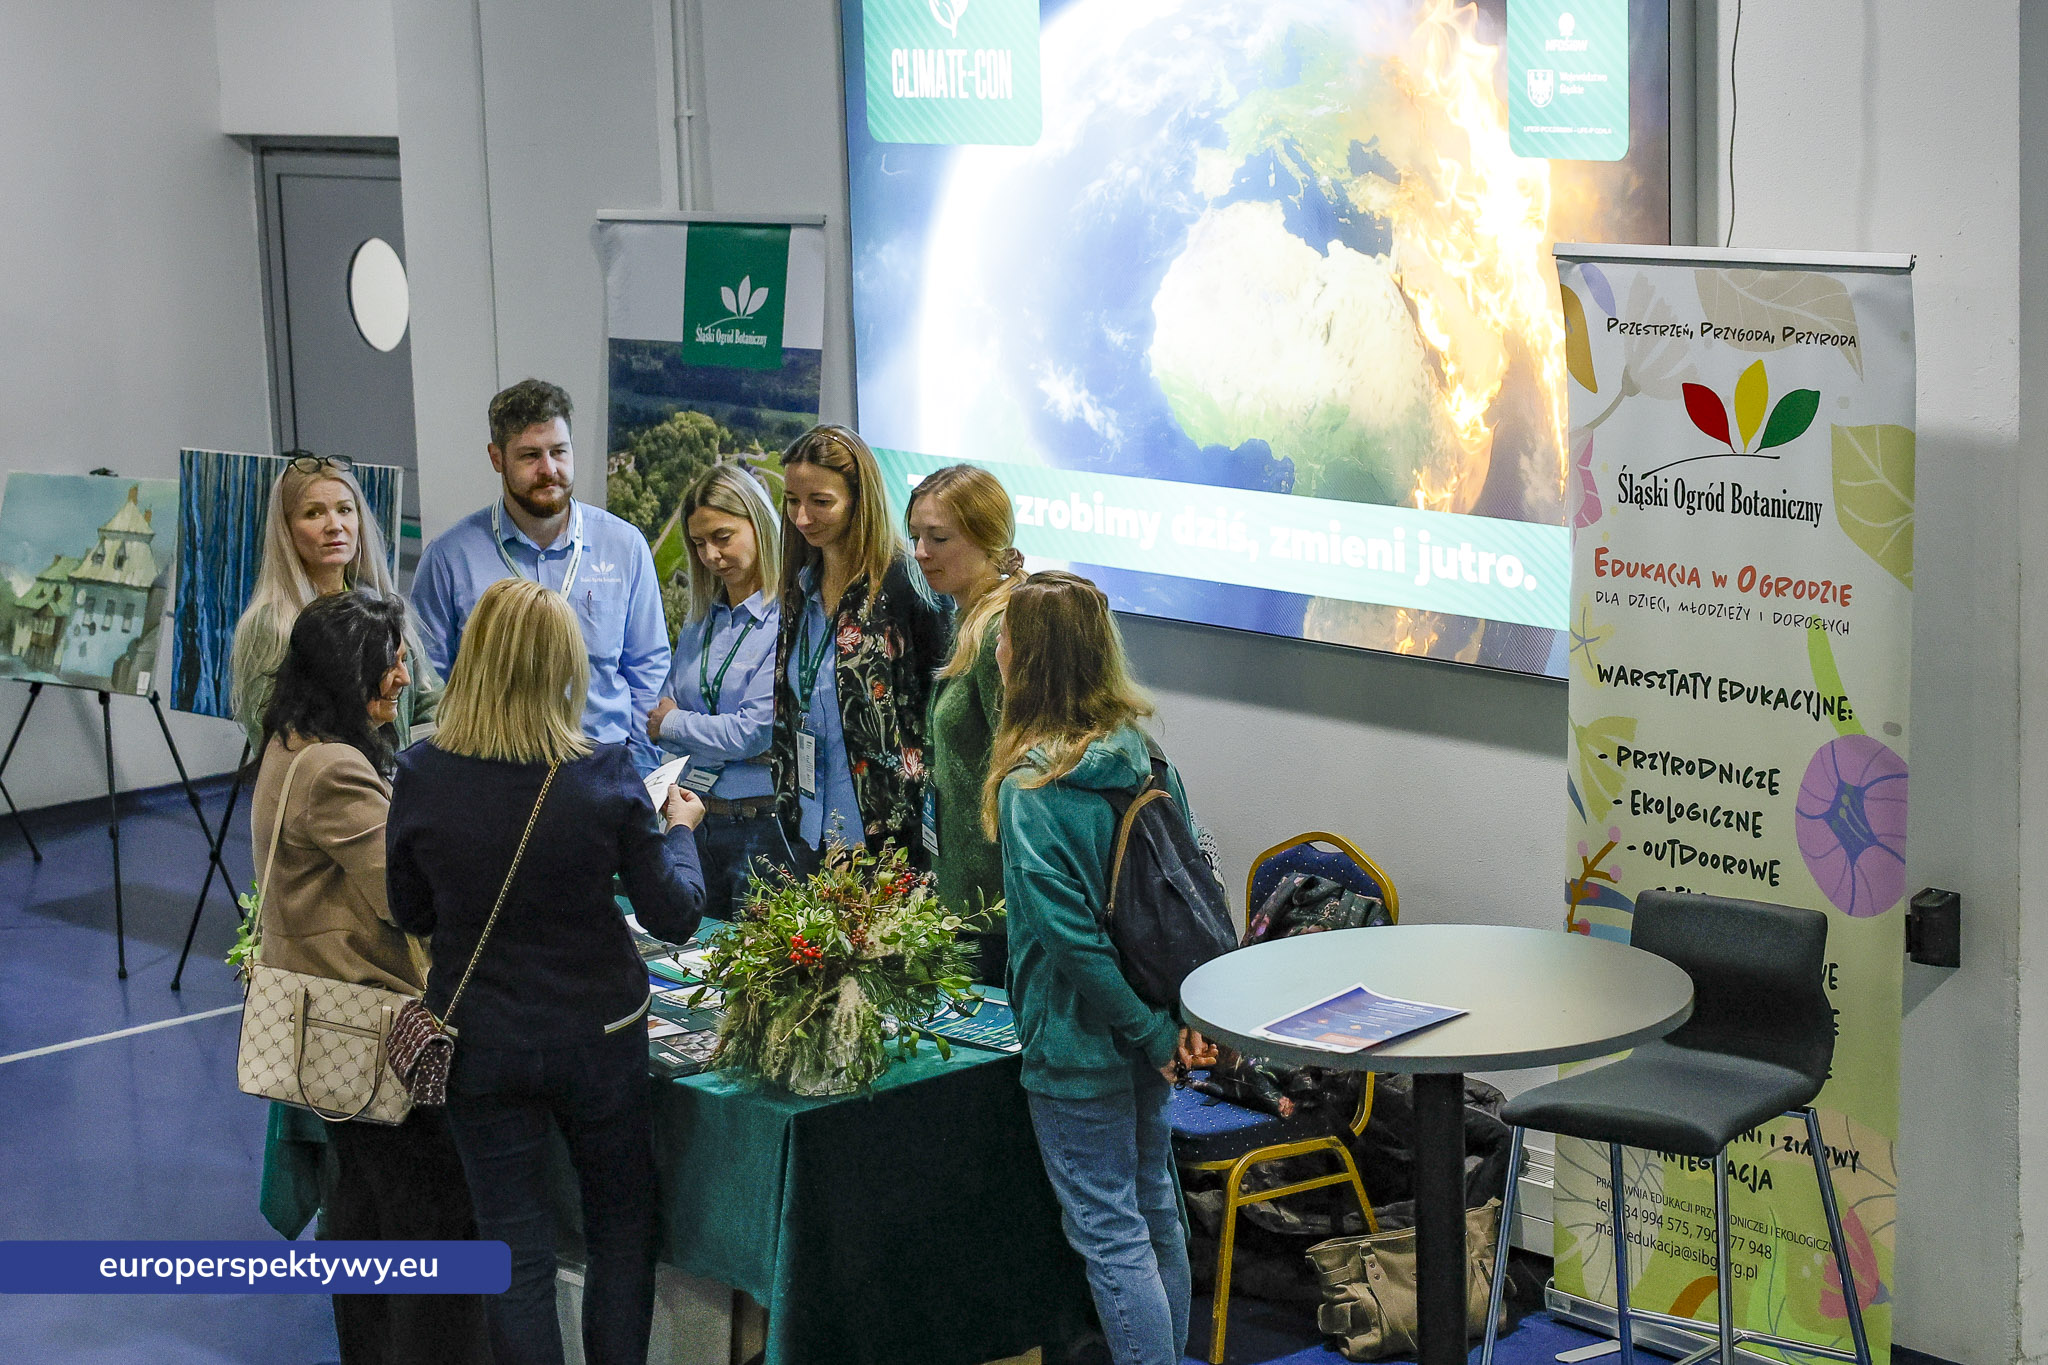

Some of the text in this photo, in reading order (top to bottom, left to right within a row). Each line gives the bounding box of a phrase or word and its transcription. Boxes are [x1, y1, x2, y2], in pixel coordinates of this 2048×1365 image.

[890, 48, 1013, 100] CLIMATE-CON
[695, 323, 768, 348] Śląski Ogród Botaniczny
[1607, 317, 1857, 348] PRZESTRZEŃ, PRZYGODA, PRZYRODA
[1618, 464, 1823, 528] Śląski Ogród Botaniczny
[1015, 491, 1537, 591] zrobimy dziś, zmieni jutro.
[1594, 546, 1701, 589] EDUKACJA
[1737, 565, 1853, 607] OGRODZIE
[1596, 591, 1620, 606] DLA
[1628, 594, 1670, 613] DZIECI,
[1773, 612, 1850, 635] DOROSŁYCH
[1597, 664, 1853, 722] WARSZTATY EDUKACYJNE:
[1617, 746, 1780, 796] PRZYRODNICZE
[1630, 790, 1763, 839] EKOLOGICZNE
[1643, 839, 1781, 887] OUTDOOROWE
[1596, 1176, 1649, 1200] PRAWNIA
[1650, 1192, 1693, 1214] EDUKACJI
[1695, 1204, 1769, 1235] PRZYDNICZEJ
[1596, 1197, 1613, 1214] tel.
[1641, 1209, 1663, 1228] 994
[1667, 1217, 1693, 1239] 575,
[1748, 1241, 1772, 1259] 948
